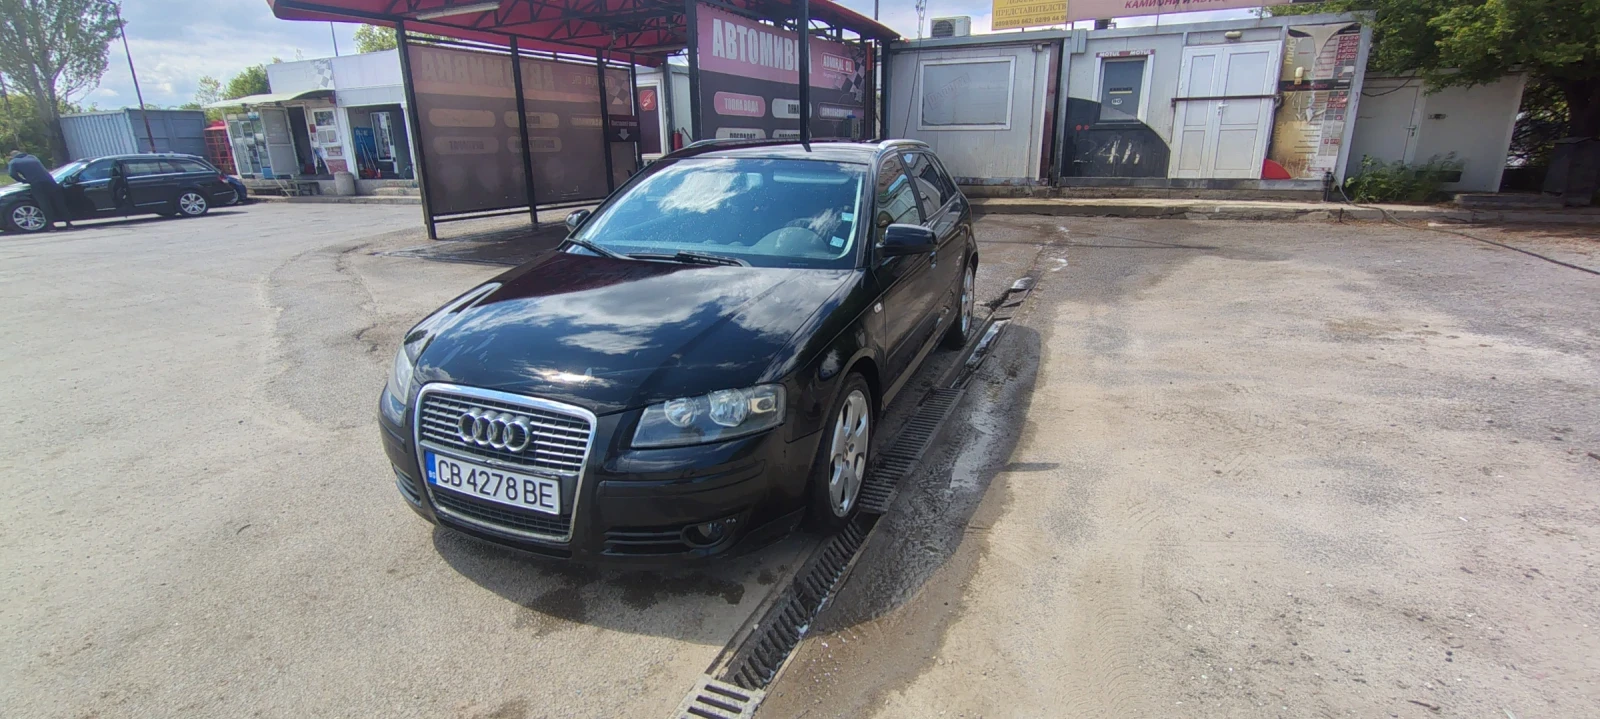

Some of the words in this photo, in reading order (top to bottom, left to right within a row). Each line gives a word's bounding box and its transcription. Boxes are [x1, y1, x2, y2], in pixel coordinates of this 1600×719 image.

[995, 3, 1067, 17] ПРЕДСТАВИТЕЛСТВ
[712, 18, 813, 74] АВТОМИВ
[438, 460, 462, 487] CB
[467, 468, 518, 501] 4278
[523, 479, 554, 509] BE
